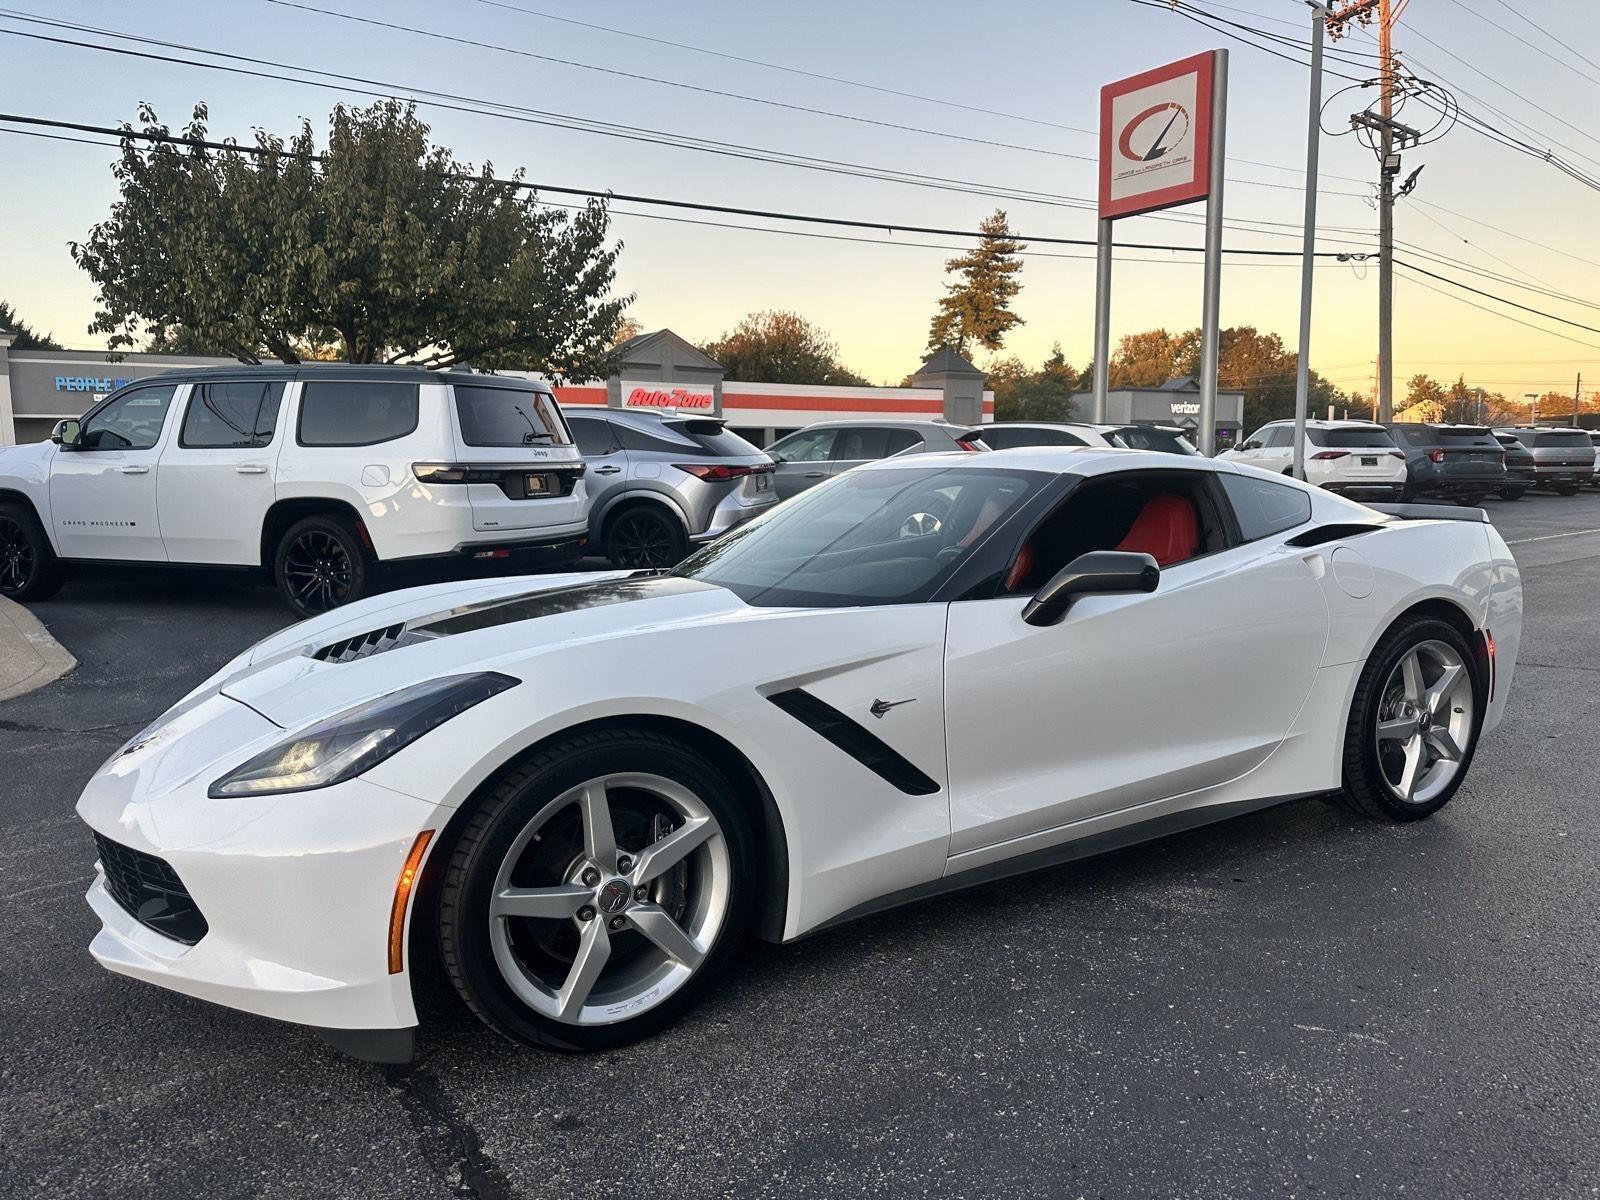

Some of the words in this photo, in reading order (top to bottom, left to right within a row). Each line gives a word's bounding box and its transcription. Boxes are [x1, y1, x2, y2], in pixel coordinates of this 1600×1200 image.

[55, 376, 112, 392] PEOPLE
[627, 387, 713, 409] AutoZone
[533, 449, 548, 458] Jeep
